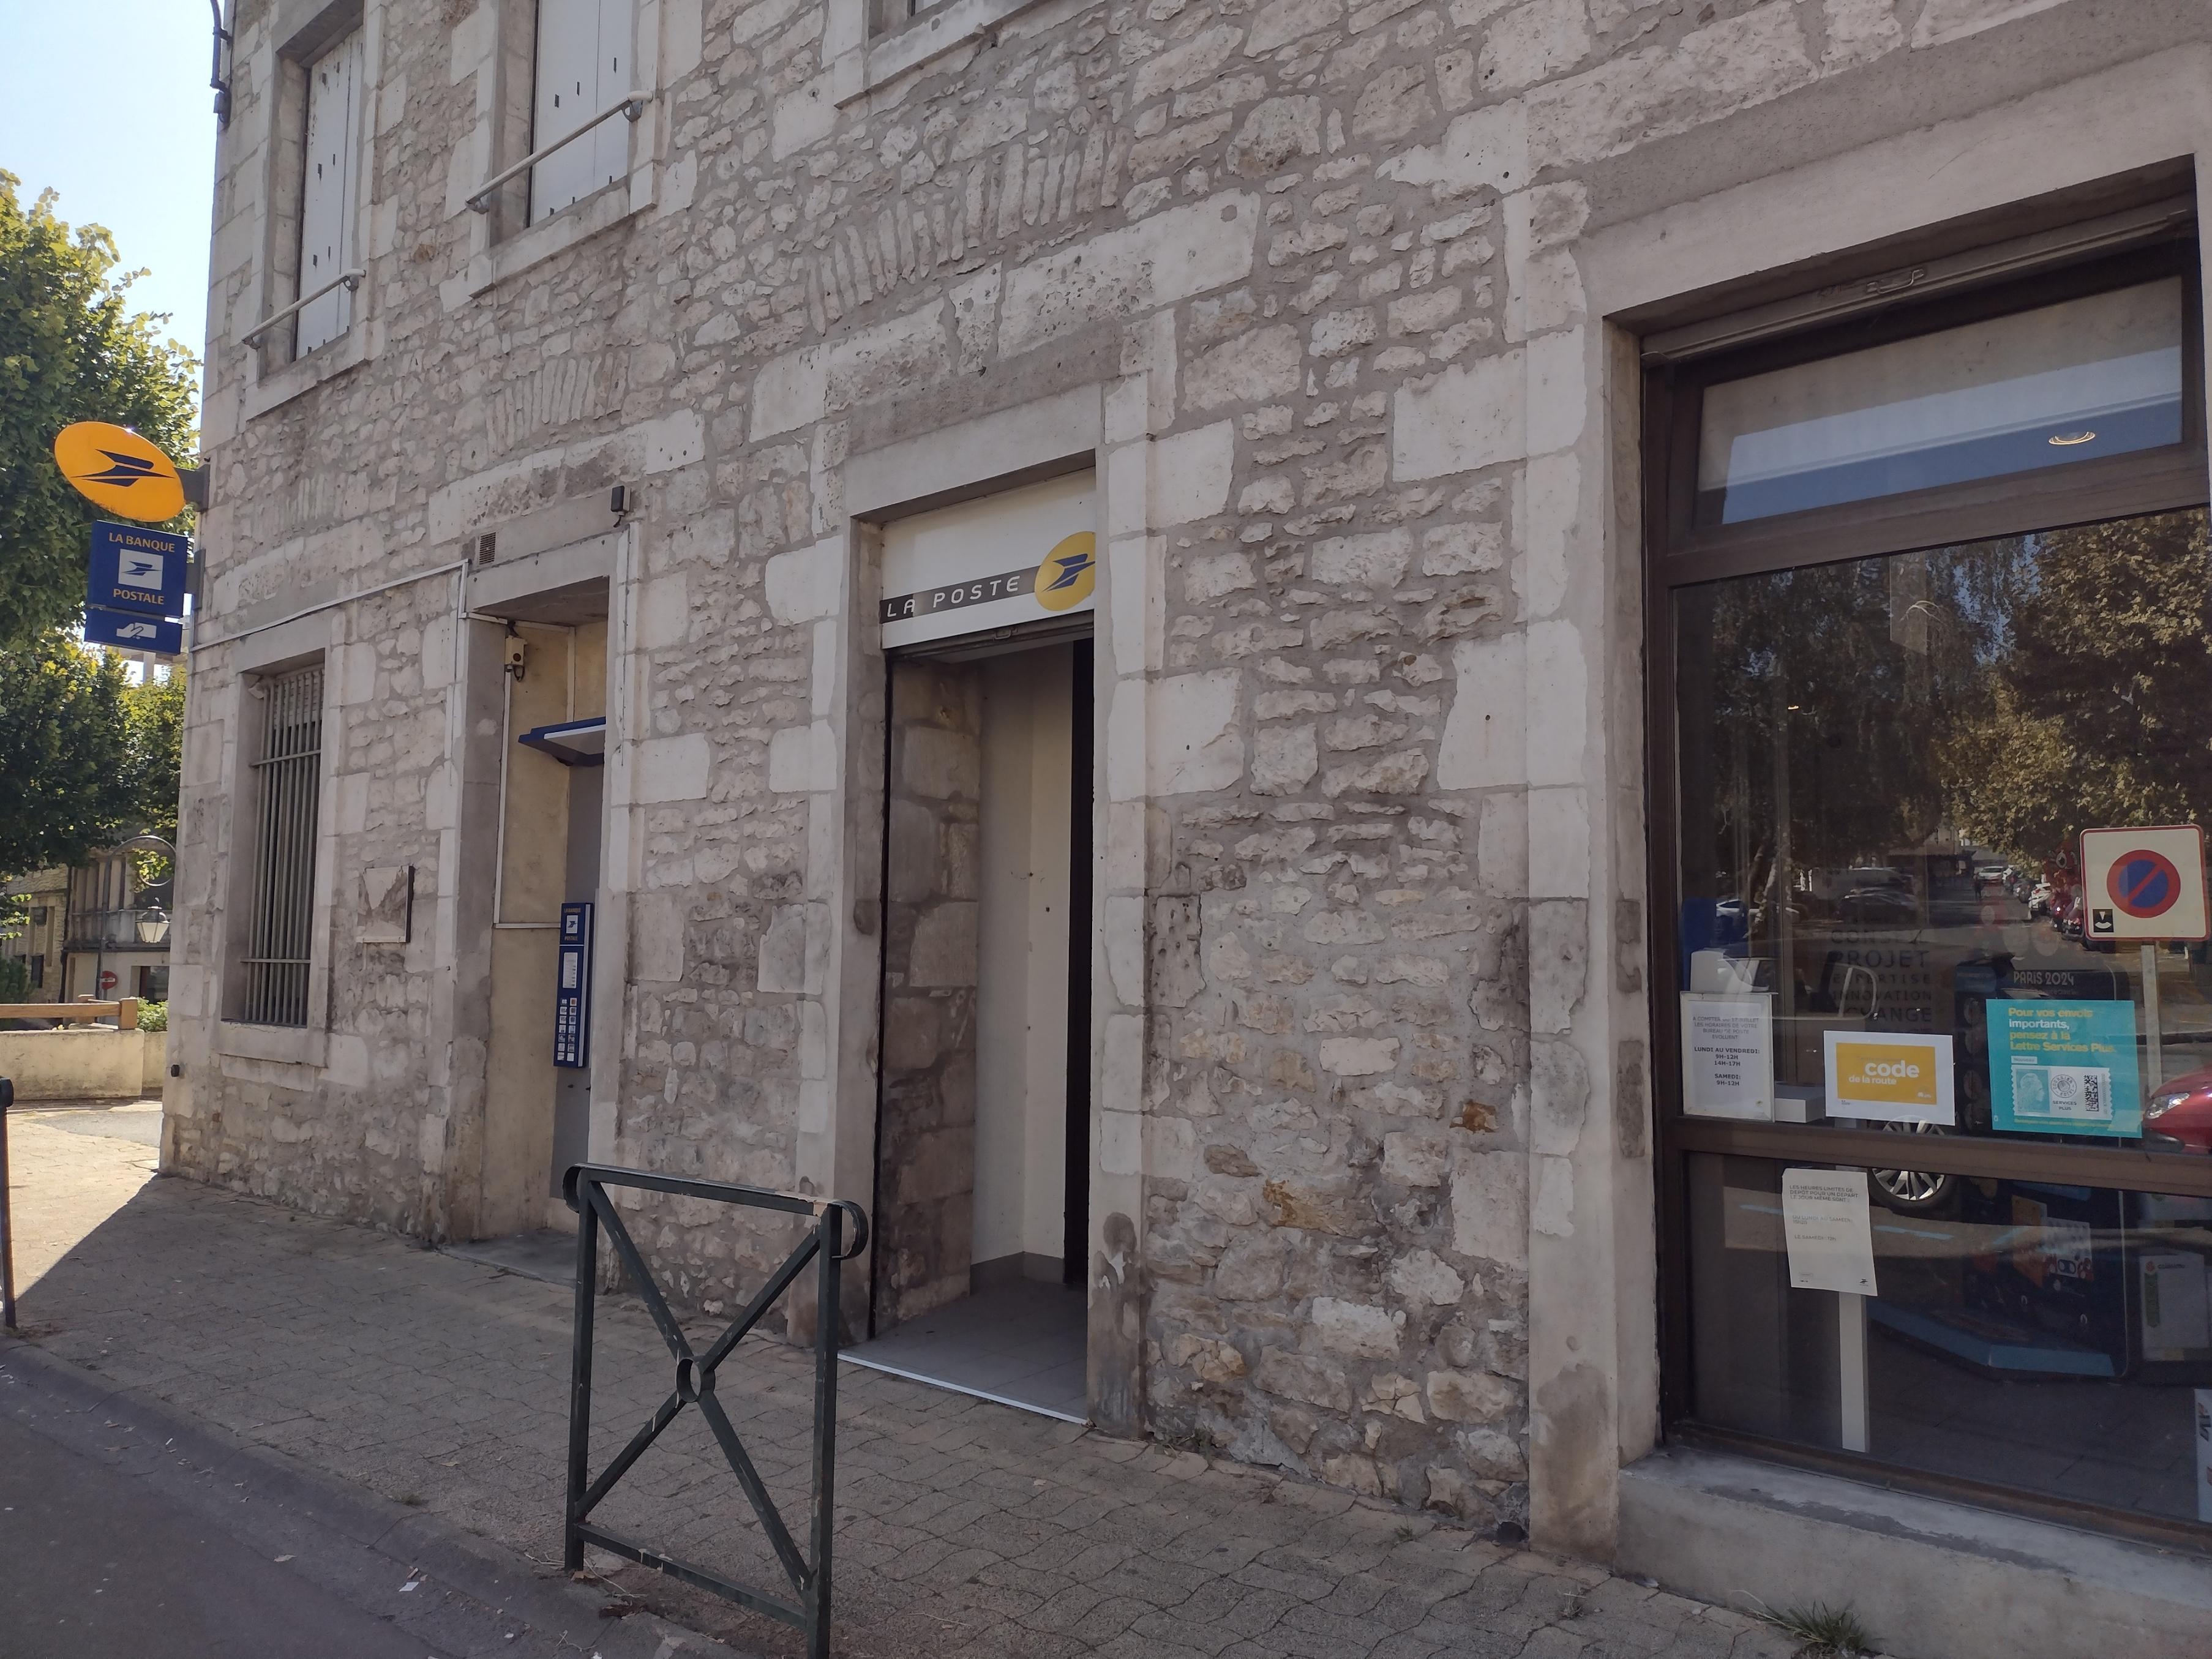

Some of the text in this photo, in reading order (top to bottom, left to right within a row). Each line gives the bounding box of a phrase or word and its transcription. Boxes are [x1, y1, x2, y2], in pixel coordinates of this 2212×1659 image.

[109, 533, 175, 552] LA BANQUE
[113, 588, 164, 604] POSTALE
[887, 576, 1021, 617] LA POSTE
[1833, 974, 1930, 984] EPERTISE
[2013, 971, 2074, 986] PARIS 2024
[2008, 1008, 2033, 1016] Pour
[2058, 1009, 2093, 1017] envois
[2009, 1019, 2069, 1030] importants,
[2011, 1042, 2040, 1050] Lettre
[2043, 1043, 2088, 1052] Services
[1865, 1060, 1920, 1078] code
[1848, 1074, 1897, 1085] de la route
